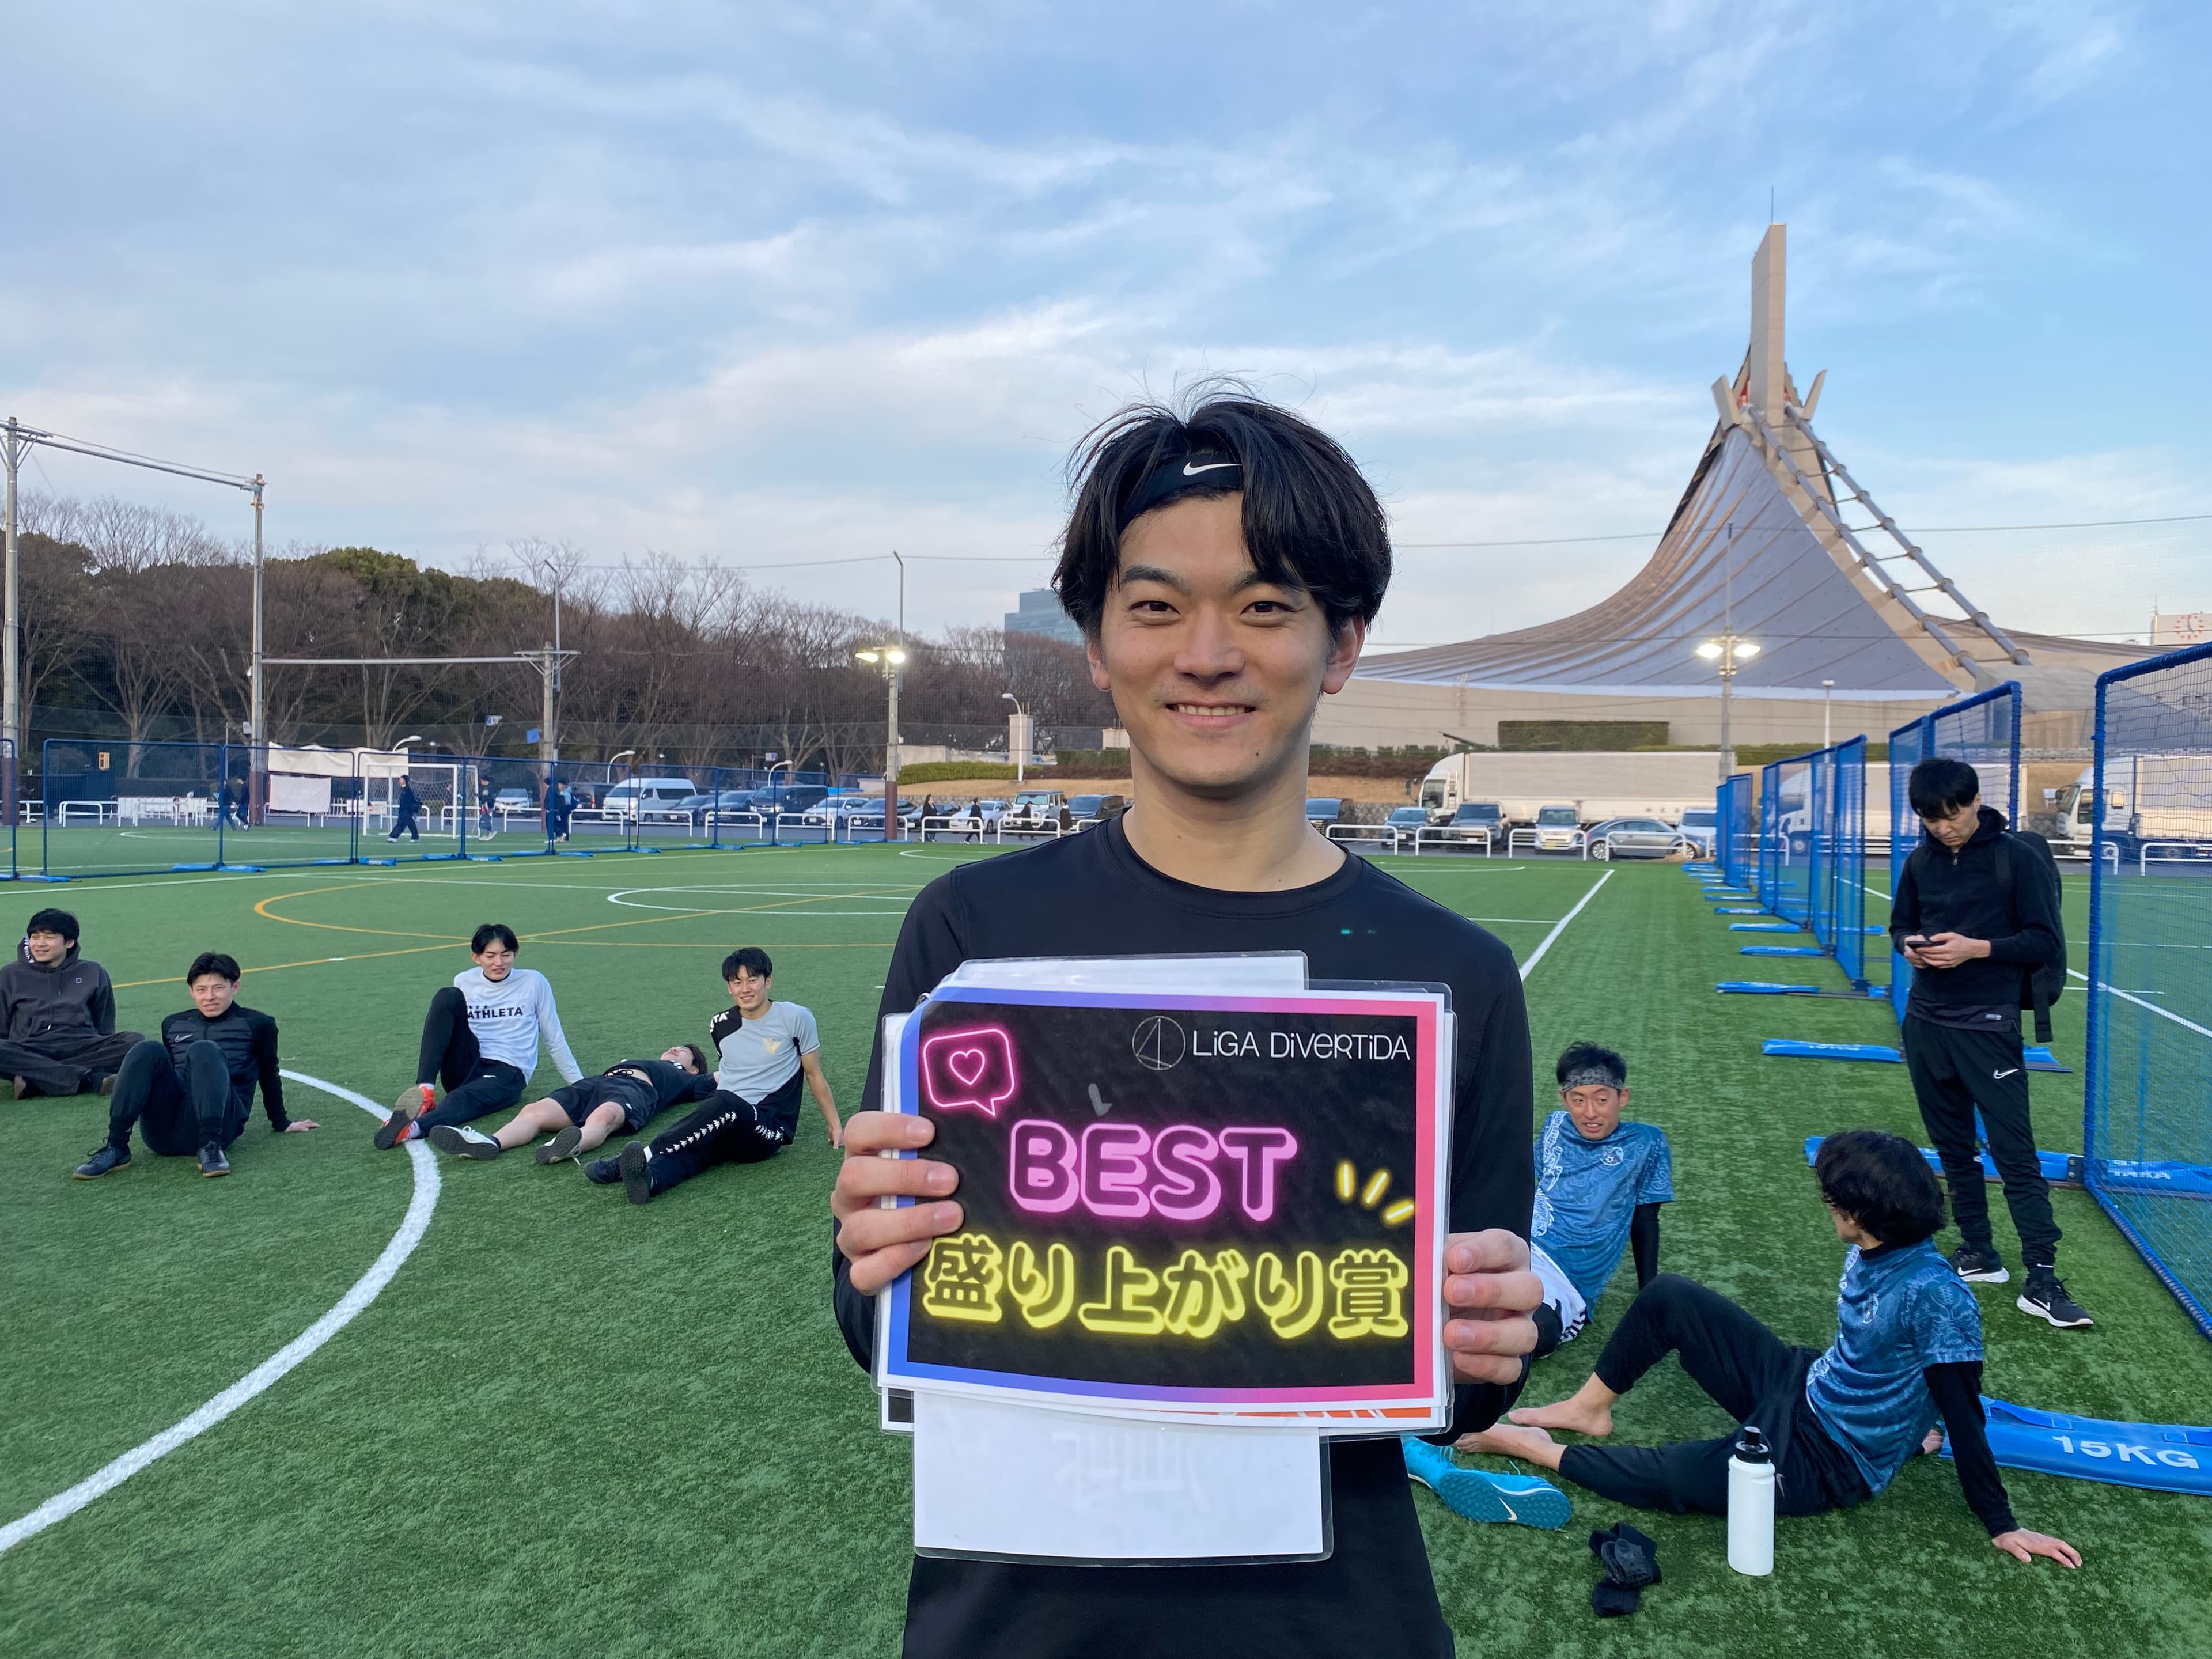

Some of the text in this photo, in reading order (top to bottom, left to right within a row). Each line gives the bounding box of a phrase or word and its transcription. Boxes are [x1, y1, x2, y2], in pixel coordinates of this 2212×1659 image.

[468, 1007, 524, 1019] ATHLETA
[1010, 1119, 1297, 1222] BEST
[923, 1233, 1407, 1339] 盛り上がり賞
[2052, 1435, 2200, 1469] 15KG
